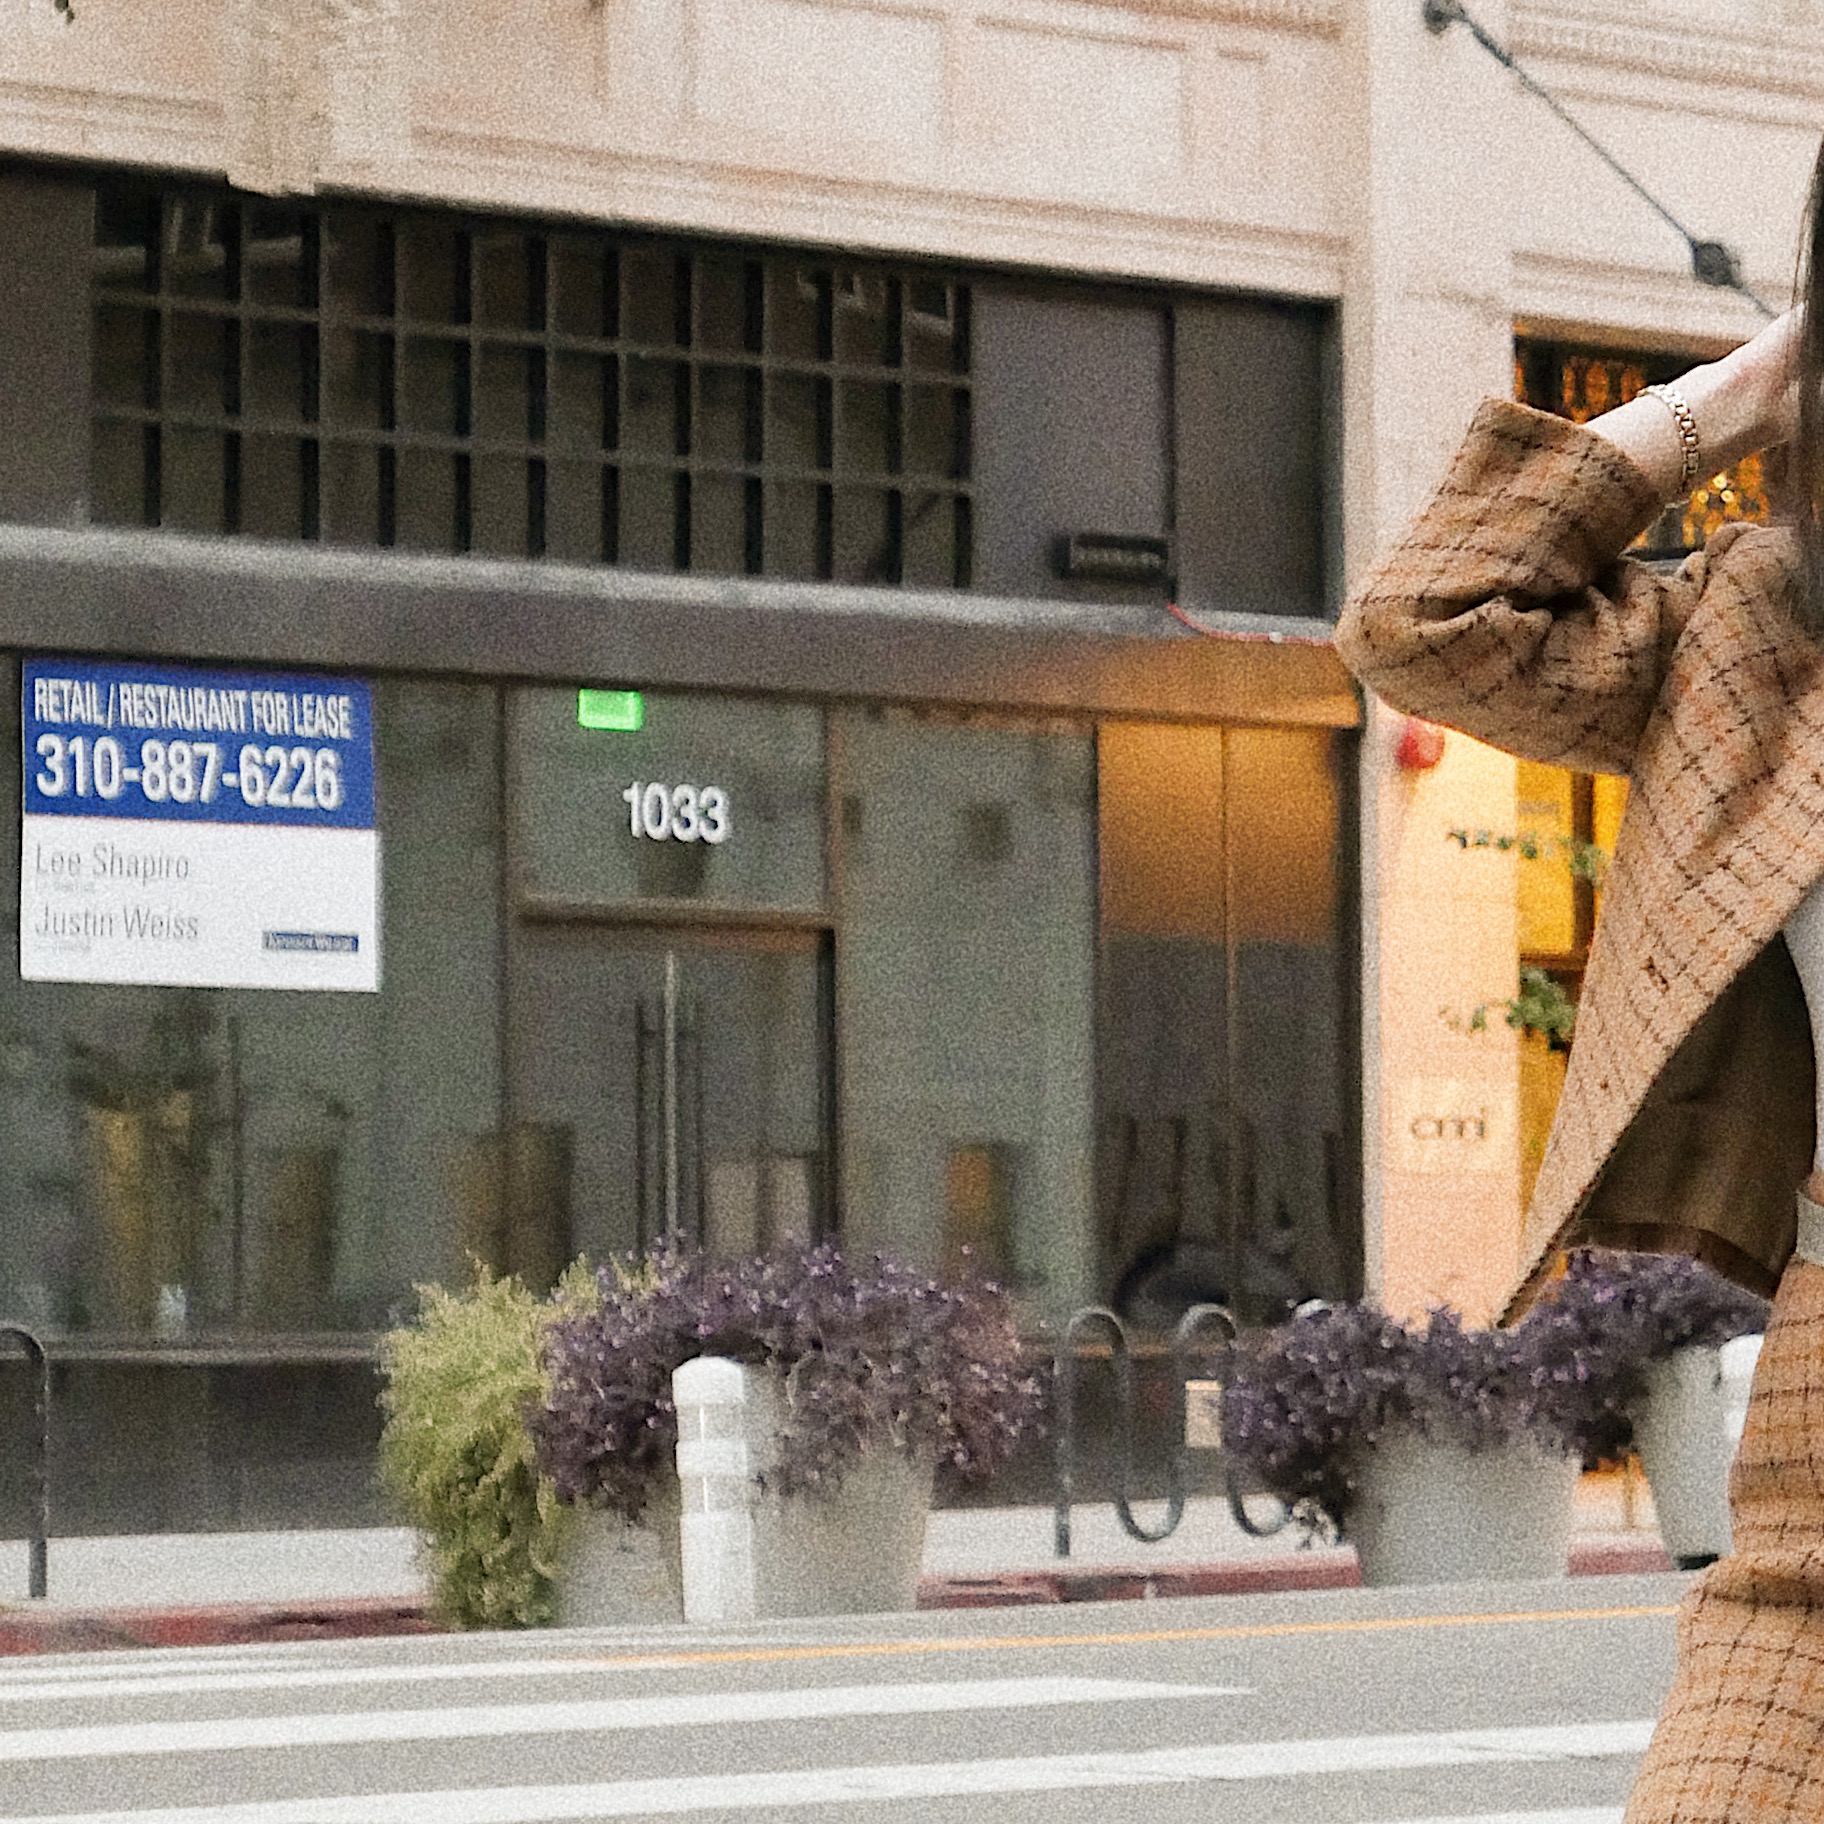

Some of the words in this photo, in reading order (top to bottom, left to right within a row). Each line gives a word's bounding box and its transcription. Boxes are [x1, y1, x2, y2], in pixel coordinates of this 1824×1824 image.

[34, 677, 105, 725] RETAIL
[119, 682, 247, 733] RESTAURANT
[250, 690, 290, 736] FOR
[293, 693, 351, 740] LEASE
[36, 733, 345, 810] 310-887-6226
[622, 780, 732, 845] 1033
[36, 842, 82, 877] Lee
[92, 841, 190, 887] Shapiro
[34, 900, 115, 940] Justin
[123, 904, 199, 942] Weiss
